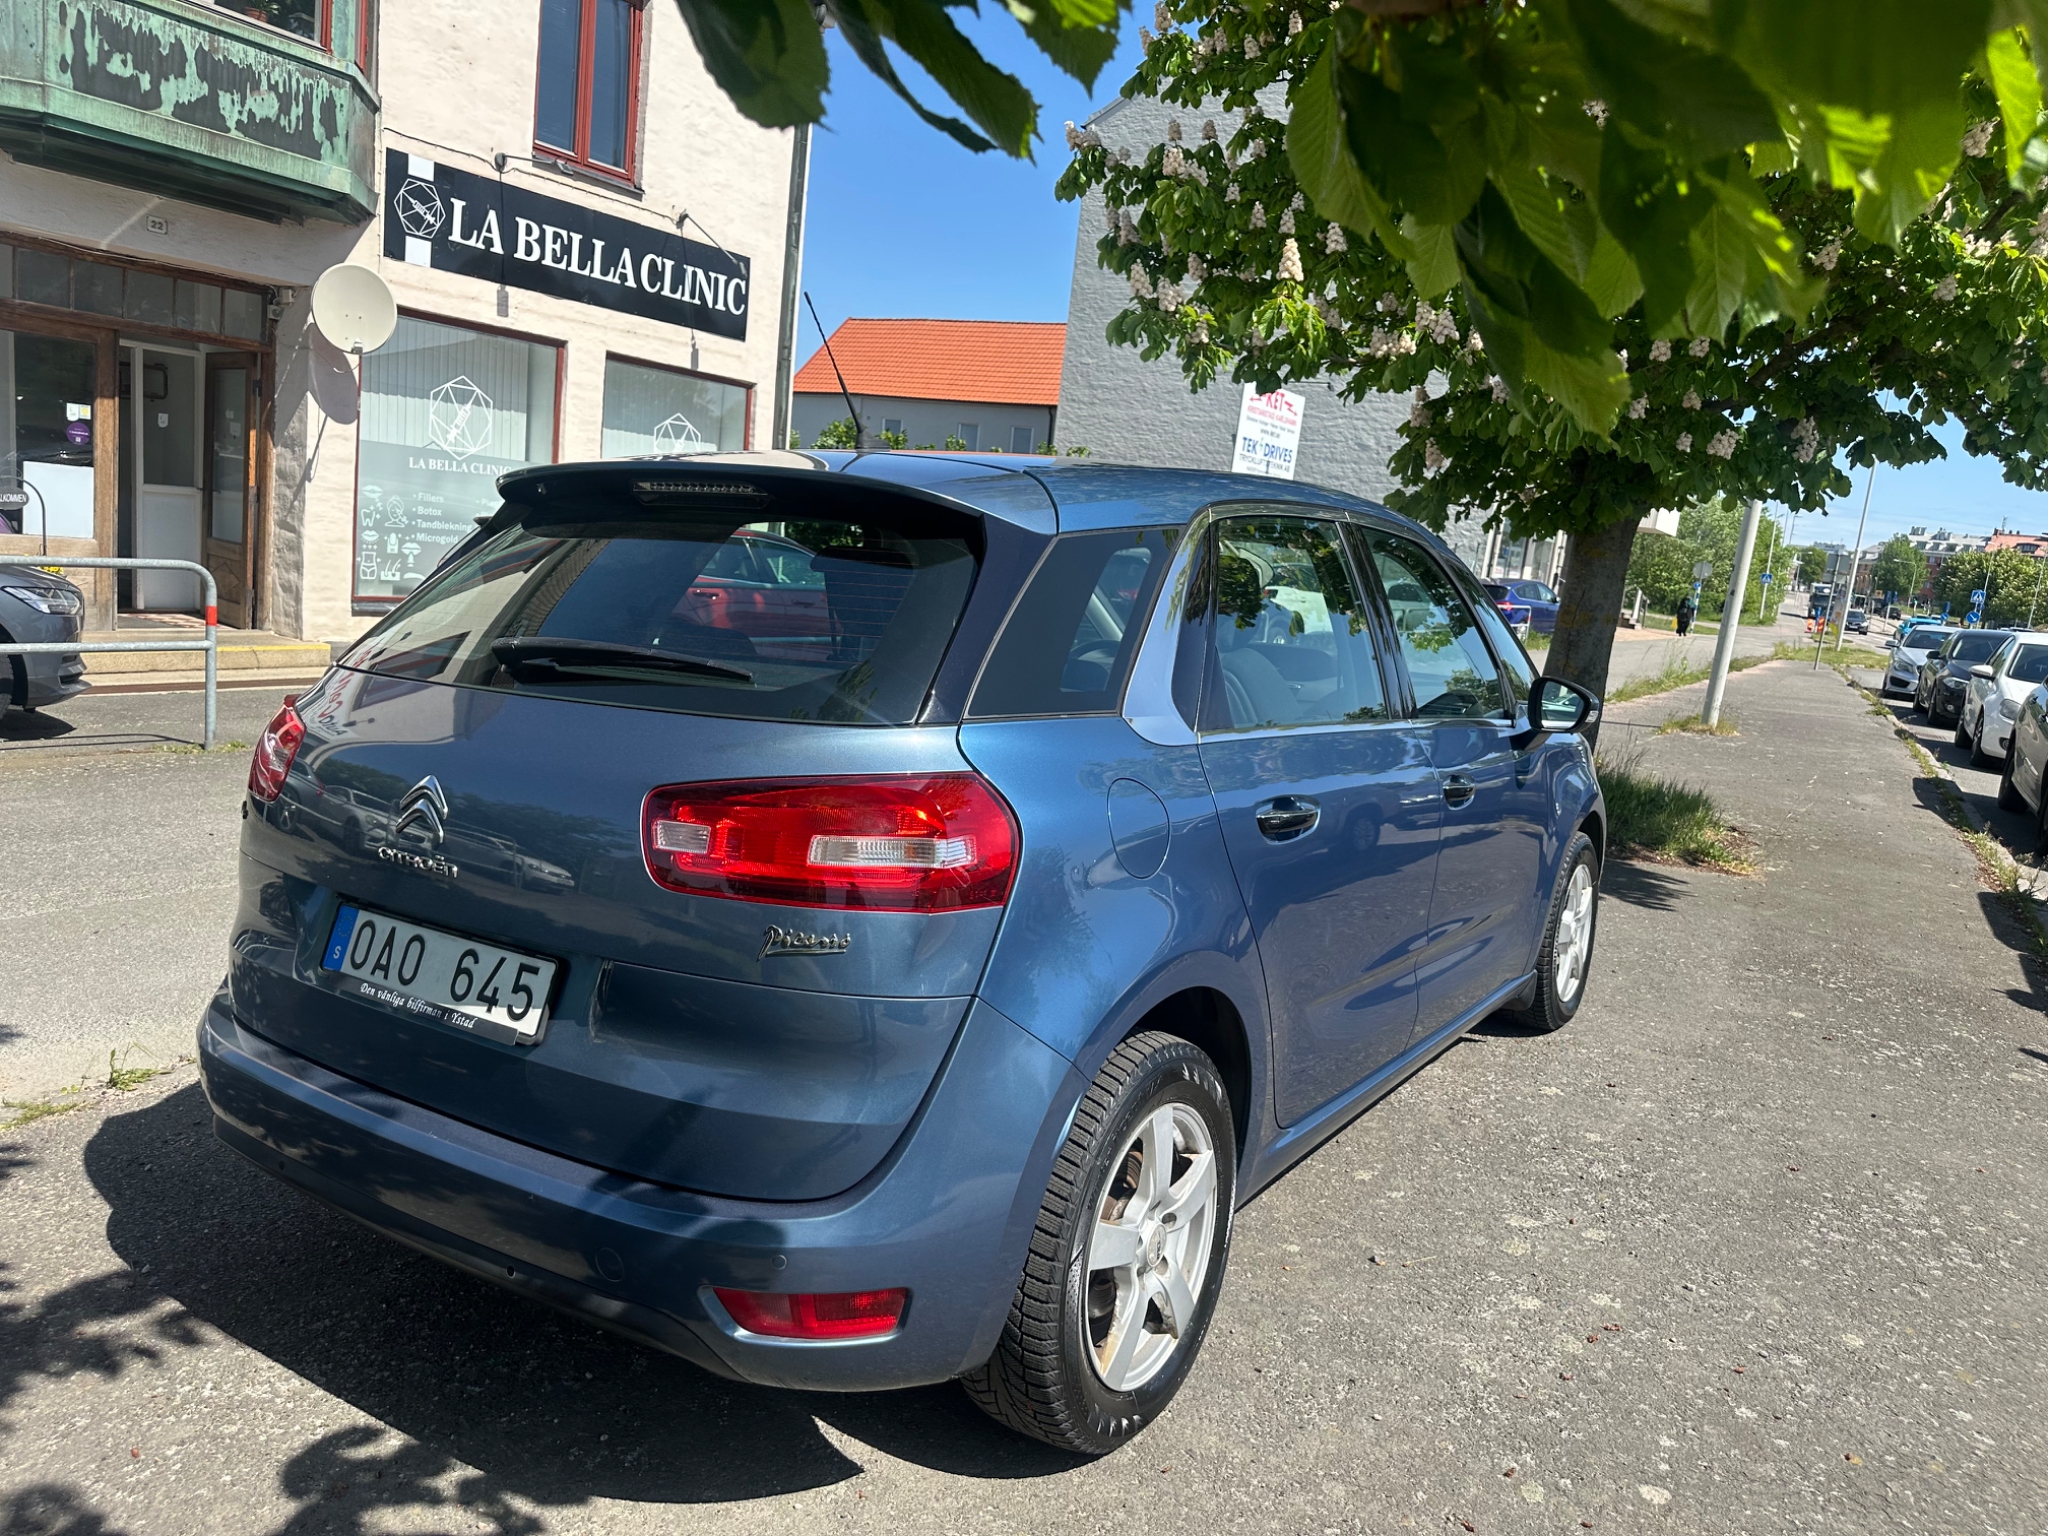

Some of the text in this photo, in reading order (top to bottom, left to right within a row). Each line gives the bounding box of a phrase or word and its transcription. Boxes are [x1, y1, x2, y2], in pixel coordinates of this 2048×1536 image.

[151, 220, 164, 231] 22
[449, 198, 504, 254] LA
[1242, 436, 1259, 455] TEK
[1263, 443, 1293, 463] DRIVES
[409, 457, 426, 469] LA
[429, 459, 468, 473] BELLA
[0, 493, 27, 502] LKOMMEN
[418, 492, 444, 503] Fillers
[418, 506, 442, 516] Botox
[417, 520, 473, 532] Tandblekning
[416, 533, 459, 544] Microgold
[333, 946, 342, 959] S
[450, 948, 541, 1022] 645
[360, 983, 375, 996] Den
[378, 989, 404, 1007] vänliga
[406, 997, 442, 1018] bilfirman
[451, 1012, 479, 1028] Ystad
